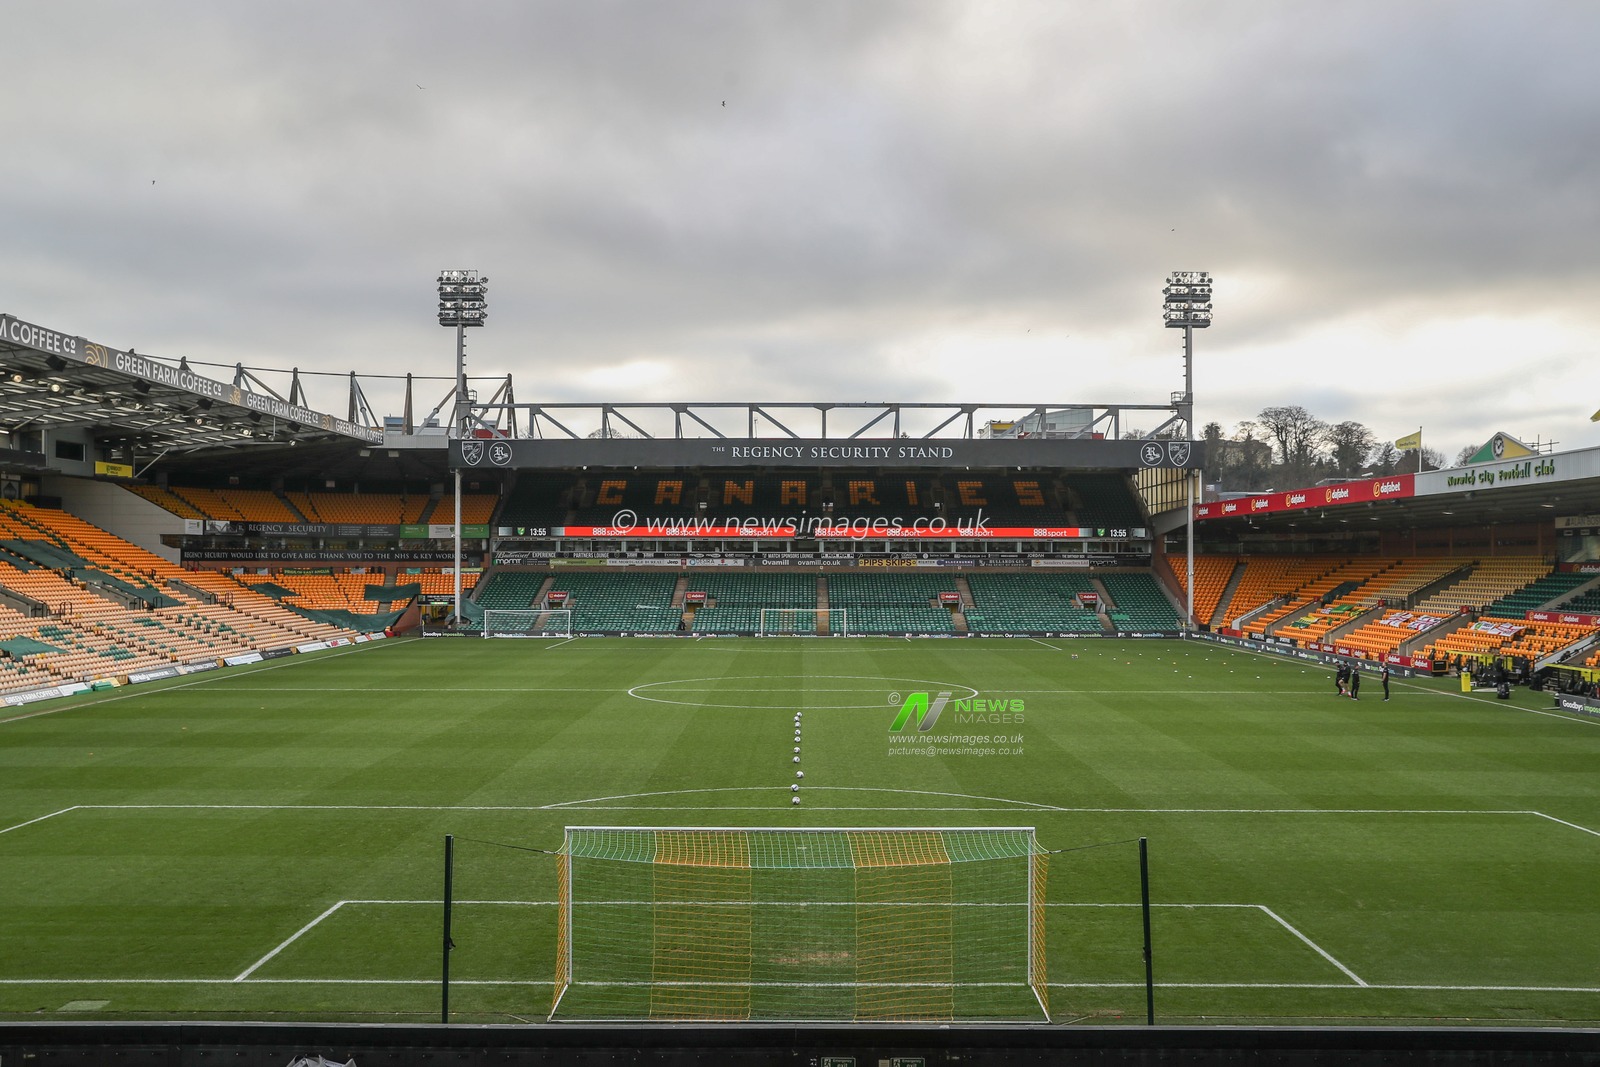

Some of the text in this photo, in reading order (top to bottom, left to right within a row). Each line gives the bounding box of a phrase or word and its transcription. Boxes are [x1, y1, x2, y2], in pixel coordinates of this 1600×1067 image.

[10, 322, 60, 352] COFFEE
[116, 354, 150, 378] GREEN
[153, 366, 178, 386] FARM
[180, 373, 212, 395] COFFEE
[247, 393, 270, 412] GREEN
[272, 402, 289, 417] FARM
[290, 406, 312, 424] COFFEE
[336, 420, 383, 443] GREEN FARM COFFEE
[732, 446, 804, 458] REGENCY
[810, 446, 892, 459] SECURITY
[898, 446, 954, 459] STAND
[1448, 460, 1555, 486] Norwich City Football Club
[596, 480, 1044, 505] CANARIES
[1380, 482, 1400, 493] dafabet
[1291, 494, 1306, 504] dafabet
[1332, 488, 1349, 500] dafabet
[1226, 503, 1237, 512] dafabet
[1256, 500, 1268, 508] dafabet
[289, 524, 327, 533] SECURITY
[592, 528, 626, 536] 888sport
[5, 694, 23, 704] GREEN
[1563, 700, 1583, 711] Goodbye
